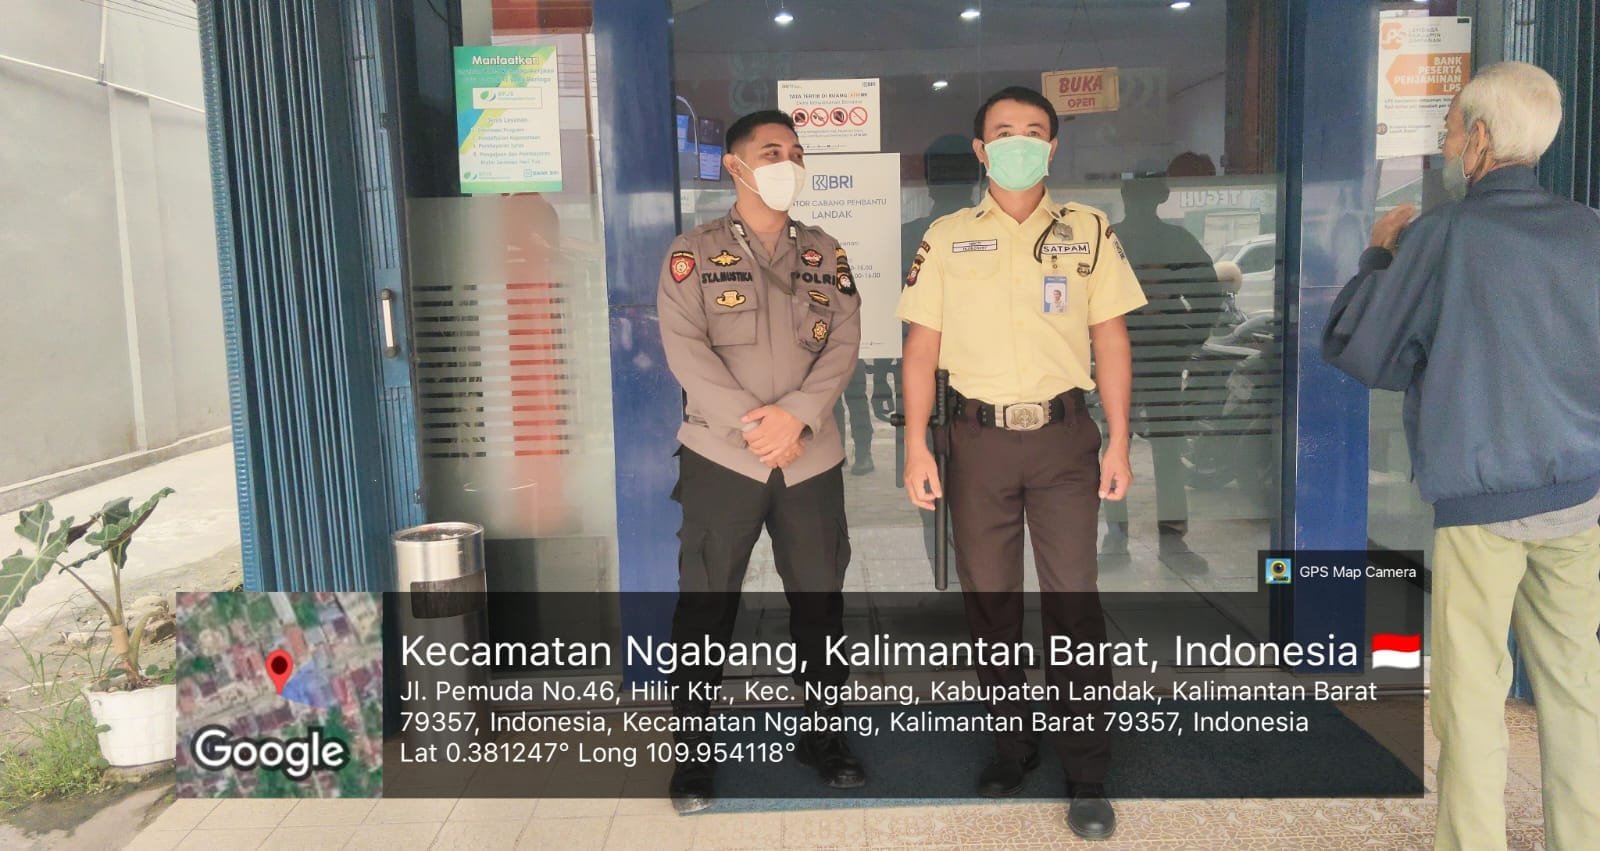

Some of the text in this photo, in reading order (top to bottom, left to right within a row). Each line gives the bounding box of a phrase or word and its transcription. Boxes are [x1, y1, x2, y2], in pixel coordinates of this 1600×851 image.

[1434, 56, 1463, 65] BANK
[1418, 65, 1463, 74] PESERTA
[1059, 75, 1103, 93] BUKA
[1393, 74, 1462, 85] PENJAMINAN
[1443, 83, 1462, 92] LPS
[1068, 98, 1096, 108] OPEN
[828, 175, 854, 190] BRI
[811, 199, 845, 207] CABANG
[846, 198, 887, 206] PEMBANTU
[811, 210, 853, 219] LANDAK
[1043, 244, 1088, 253] SATPAM
[790, 271, 836, 286] POLRI
